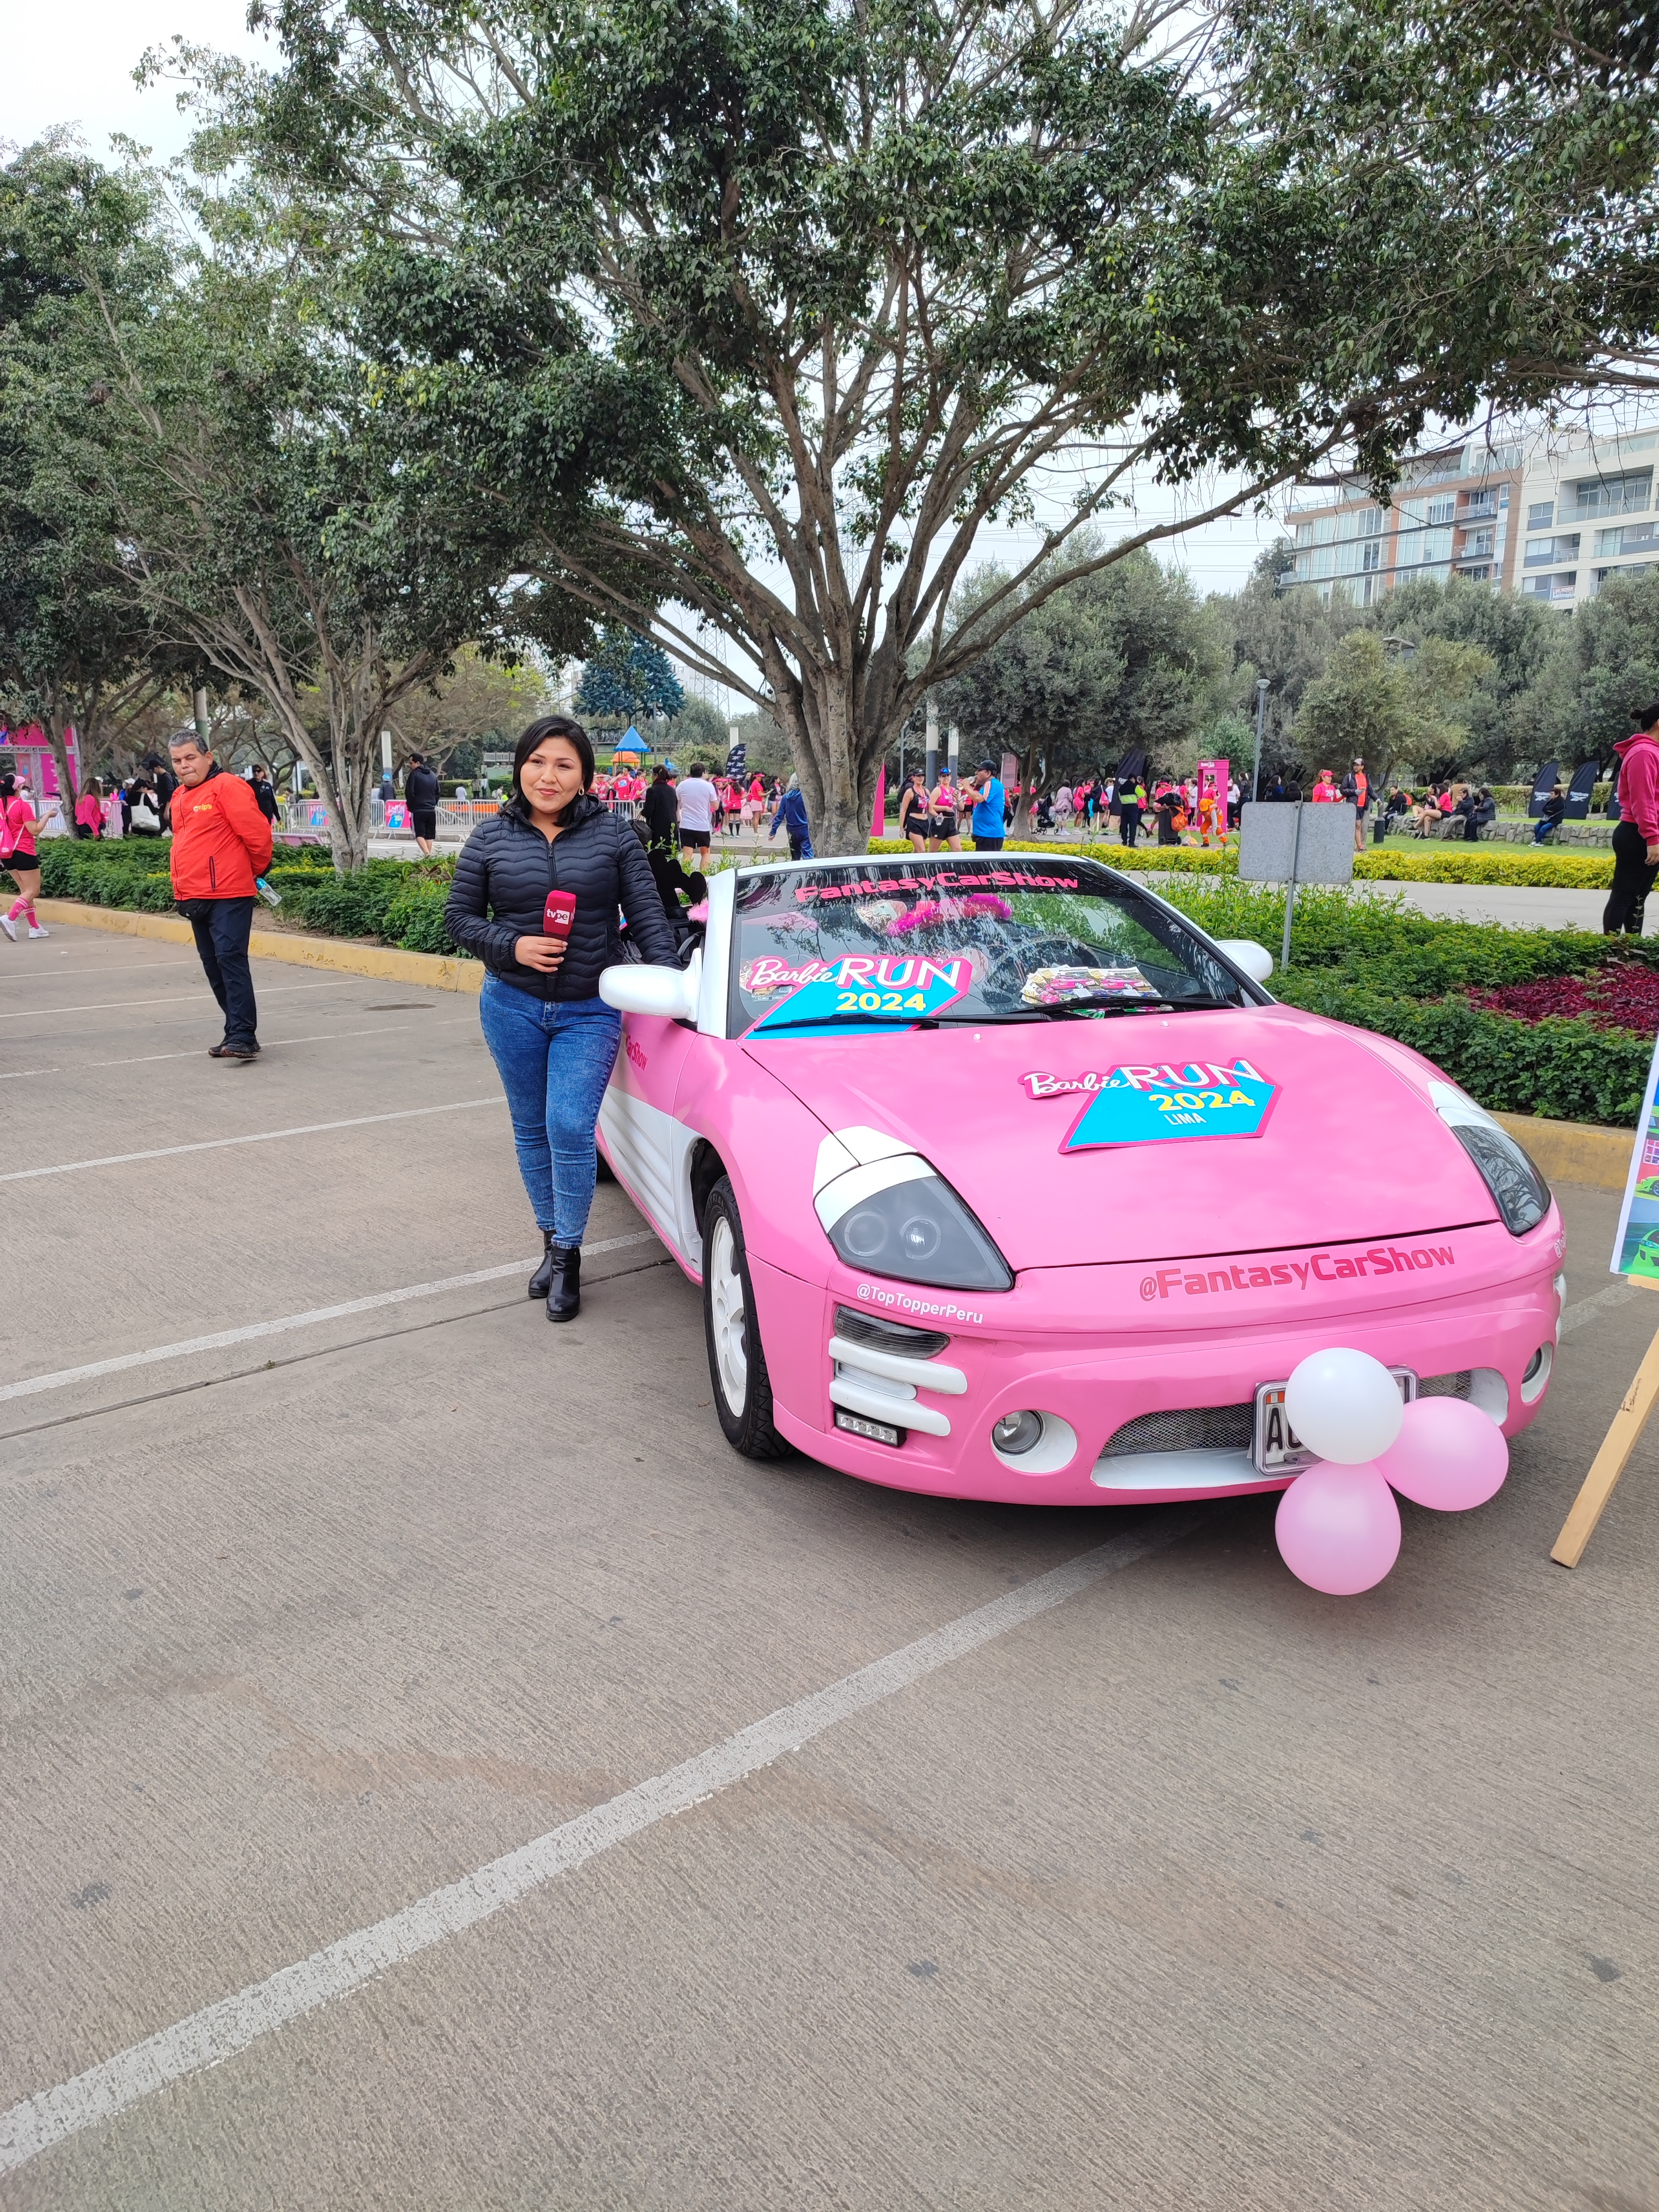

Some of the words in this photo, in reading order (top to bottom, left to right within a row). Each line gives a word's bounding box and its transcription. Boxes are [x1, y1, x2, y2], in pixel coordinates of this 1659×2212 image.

[795, 872, 1079, 902] FantasyCarShow
[753, 959, 838, 985] Barbie
[836, 957, 962, 987] RUN
[835, 992, 926, 1011] 2024
[1024, 1072, 1131, 1095] Barbie
[1118, 1060, 1265, 1089] RUN
[1148, 1090, 1256, 1112] 2024
[1163, 1113, 1208, 1126] LIMA
[1139, 1245, 1455, 1302] @FantasyCarShow
[857, 1283, 984, 1324] @TopTopperPeru
